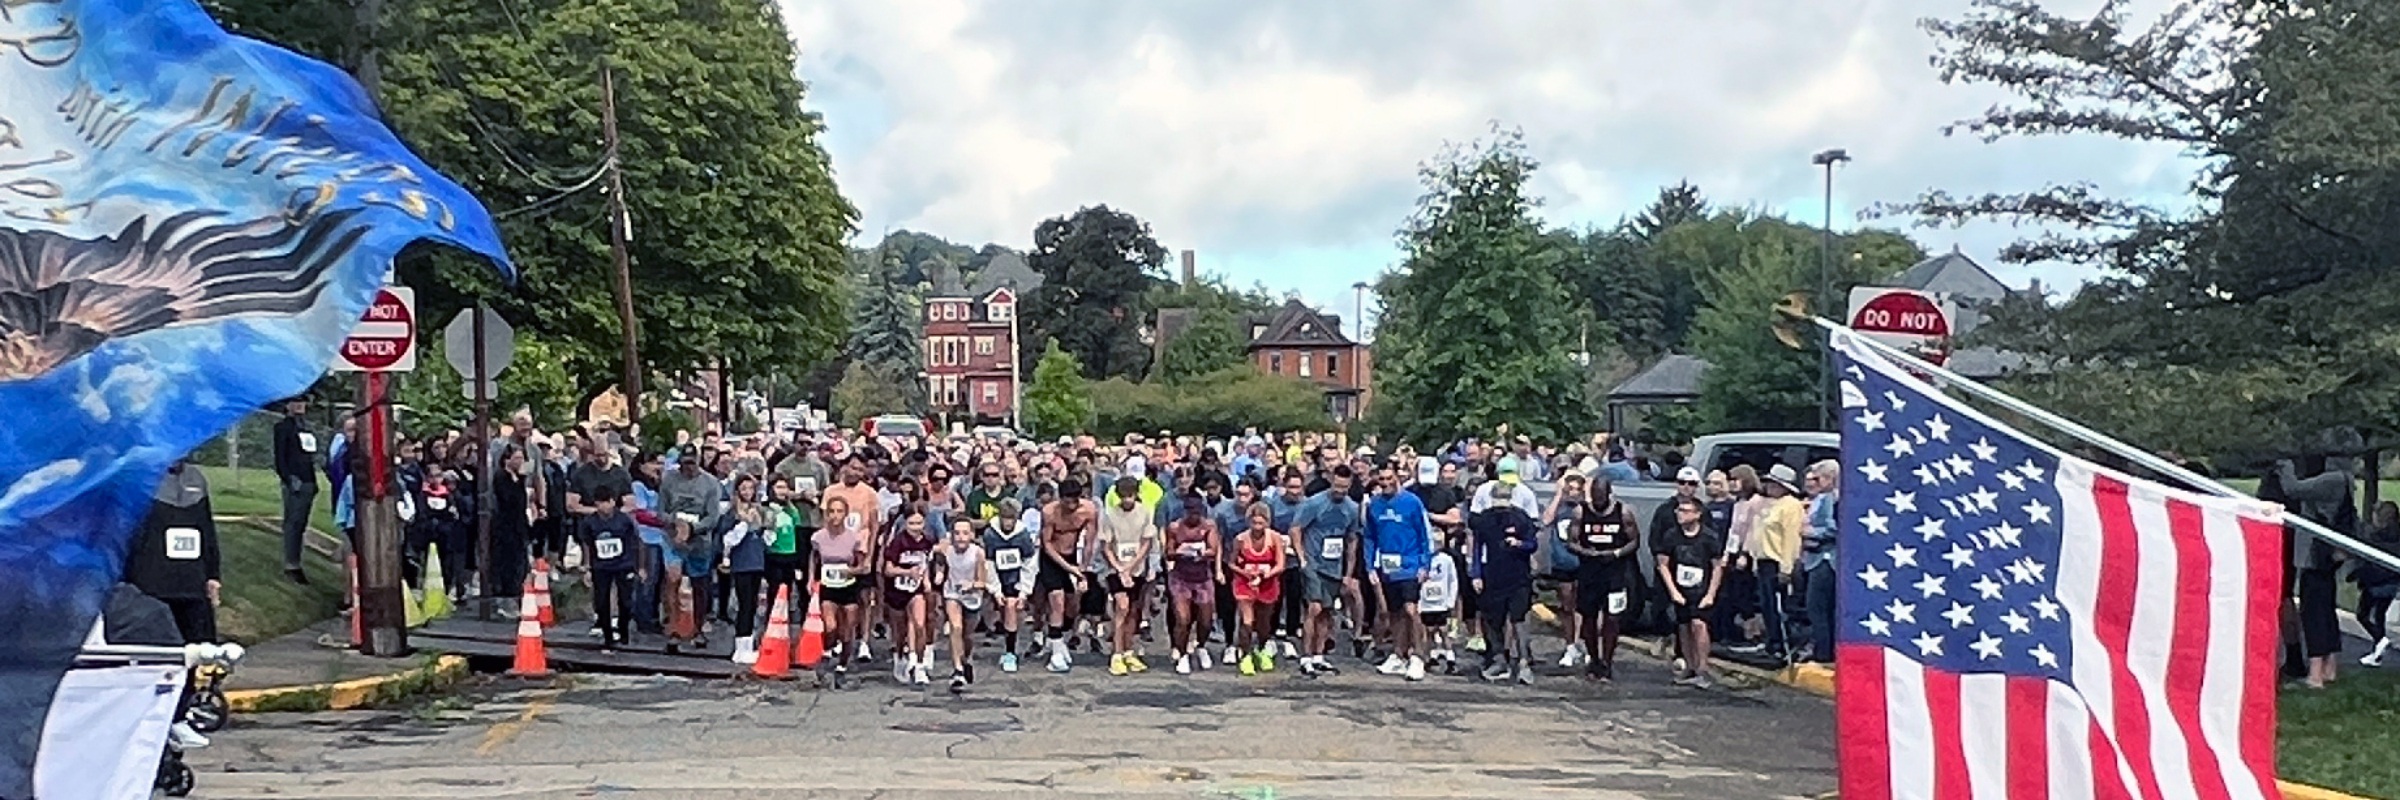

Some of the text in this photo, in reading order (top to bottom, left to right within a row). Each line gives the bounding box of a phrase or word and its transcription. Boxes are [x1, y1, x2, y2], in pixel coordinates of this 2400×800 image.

[369, 304, 399, 319] NOT
[1864, 308, 1938, 330] DO NOT
[348, 340, 397, 356] ENTER
